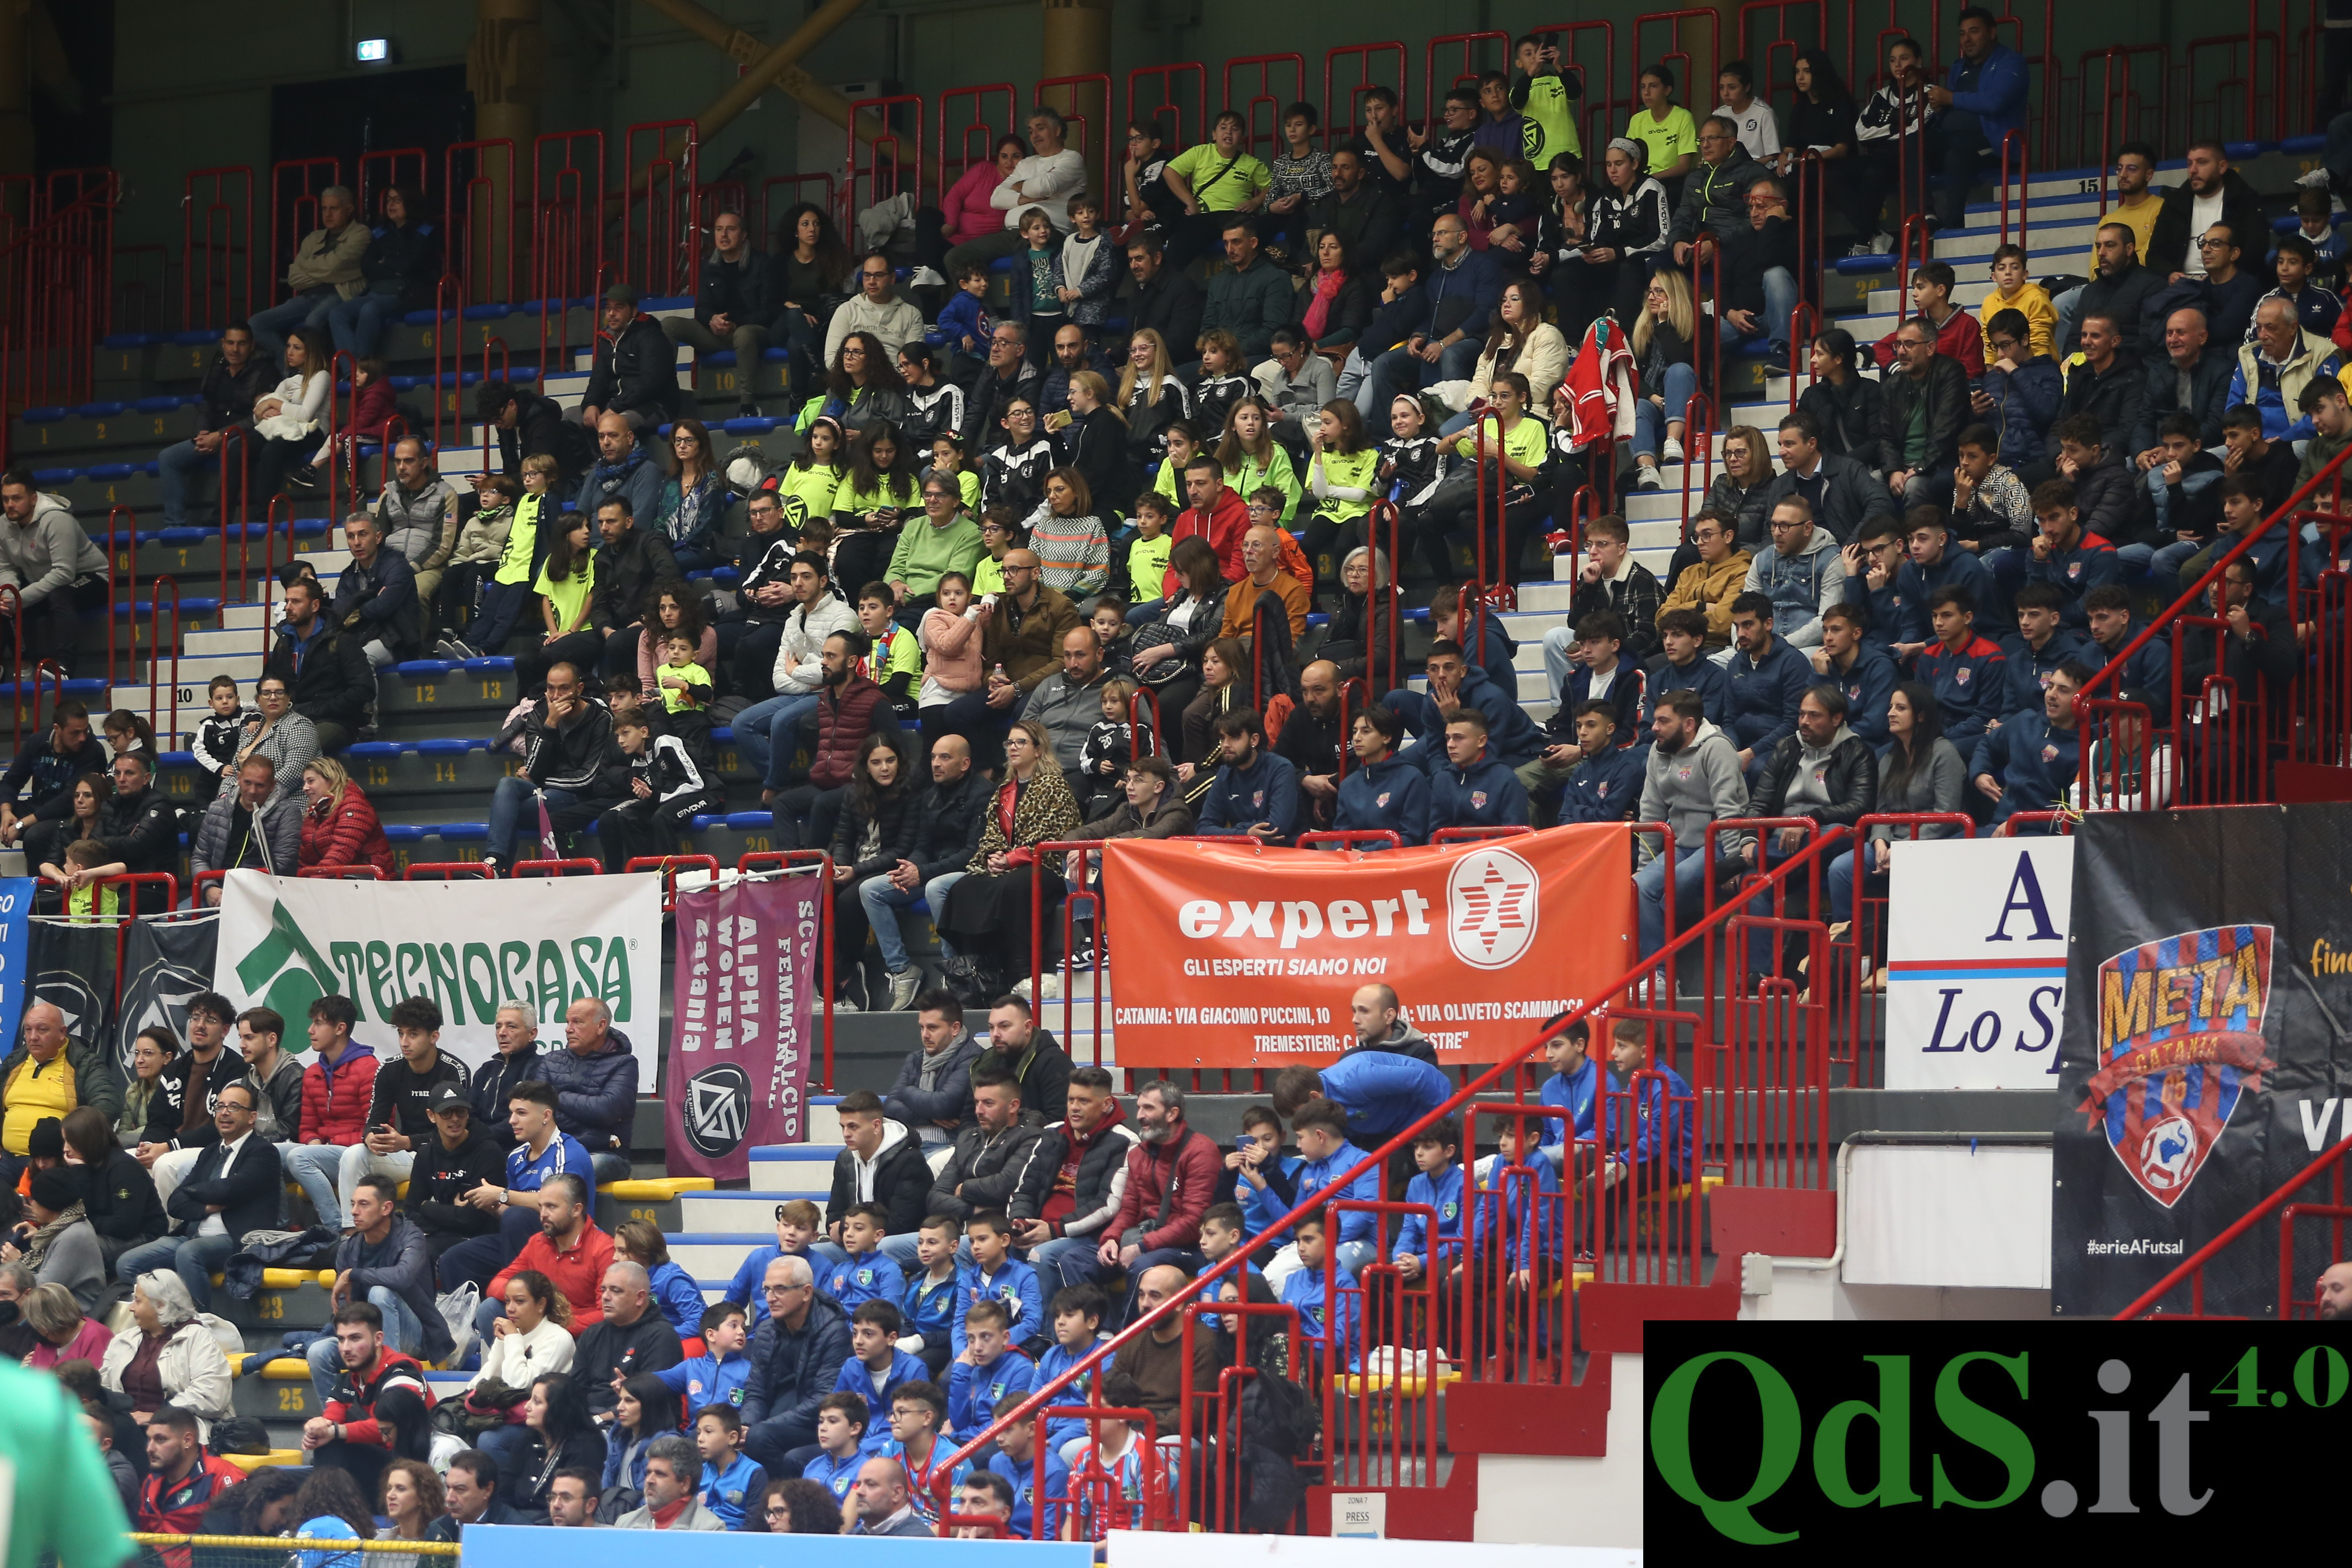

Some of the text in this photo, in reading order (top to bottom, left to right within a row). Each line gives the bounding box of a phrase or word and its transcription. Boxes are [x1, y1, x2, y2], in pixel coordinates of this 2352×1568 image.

[2079, 178, 2098, 193] 15
[1612, 219, 1621, 229] 10
[423, 331, 432, 347] 6
[123, 354, 128, 371] 1
[192, 351, 201, 367] 2
[716, 373, 734, 391] 10
[97, 423, 106, 439] 2
[154, 418, 164, 434] 3
[41, 428, 47, 444] 1
[106, 485, 115, 502] 4
[119, 552, 128, 571] 6
[178, 550, 187, 567] 7
[177, 688, 193, 702] 10
[416, 680, 502, 702] 12 13
[218, 735, 225, 744] 6
[1335, 740, 1355, 753] NS
[368, 766, 388, 785] 13
[435, 763, 456, 782] 14
[171, 775, 190, 794] 10
[676, 800, 707, 818] GIVOVA
[745, 836, 770, 854] 20
[1985, 850, 2063, 942] A
[1179, 889, 1431, 949] expert
[1184, 957, 1387, 976] GLI ESPERTI SIAMO NOI
[330, 935, 633, 1026] TECNOCASA
[681, 918, 709, 1052] Catania
[714, 914, 734, 1050] WOMEN
[738, 915, 759, 1046] ALPHA
[2102, 943, 2261, 1053] META
[1115, 1007, 1331, 1026] CATANIA: VIA GIACOMO PUCCINI, 10
[1416, 1004, 1442, 1022] VIA
[1443, 1001, 1502, 1021] OLIVETO
[1922, 988, 2001, 1053] Lo
[1254, 1034, 1341, 1053] TREMESTIERI:
[2135, 1037, 2219, 1071] CATANIA
[2087, 1238, 2183, 1255] #serieAFutsal
[259, 1296, 283, 1318] 23
[279, 1387, 305, 1411] 25
[1346, 1511, 1370, 1522] PRESS
